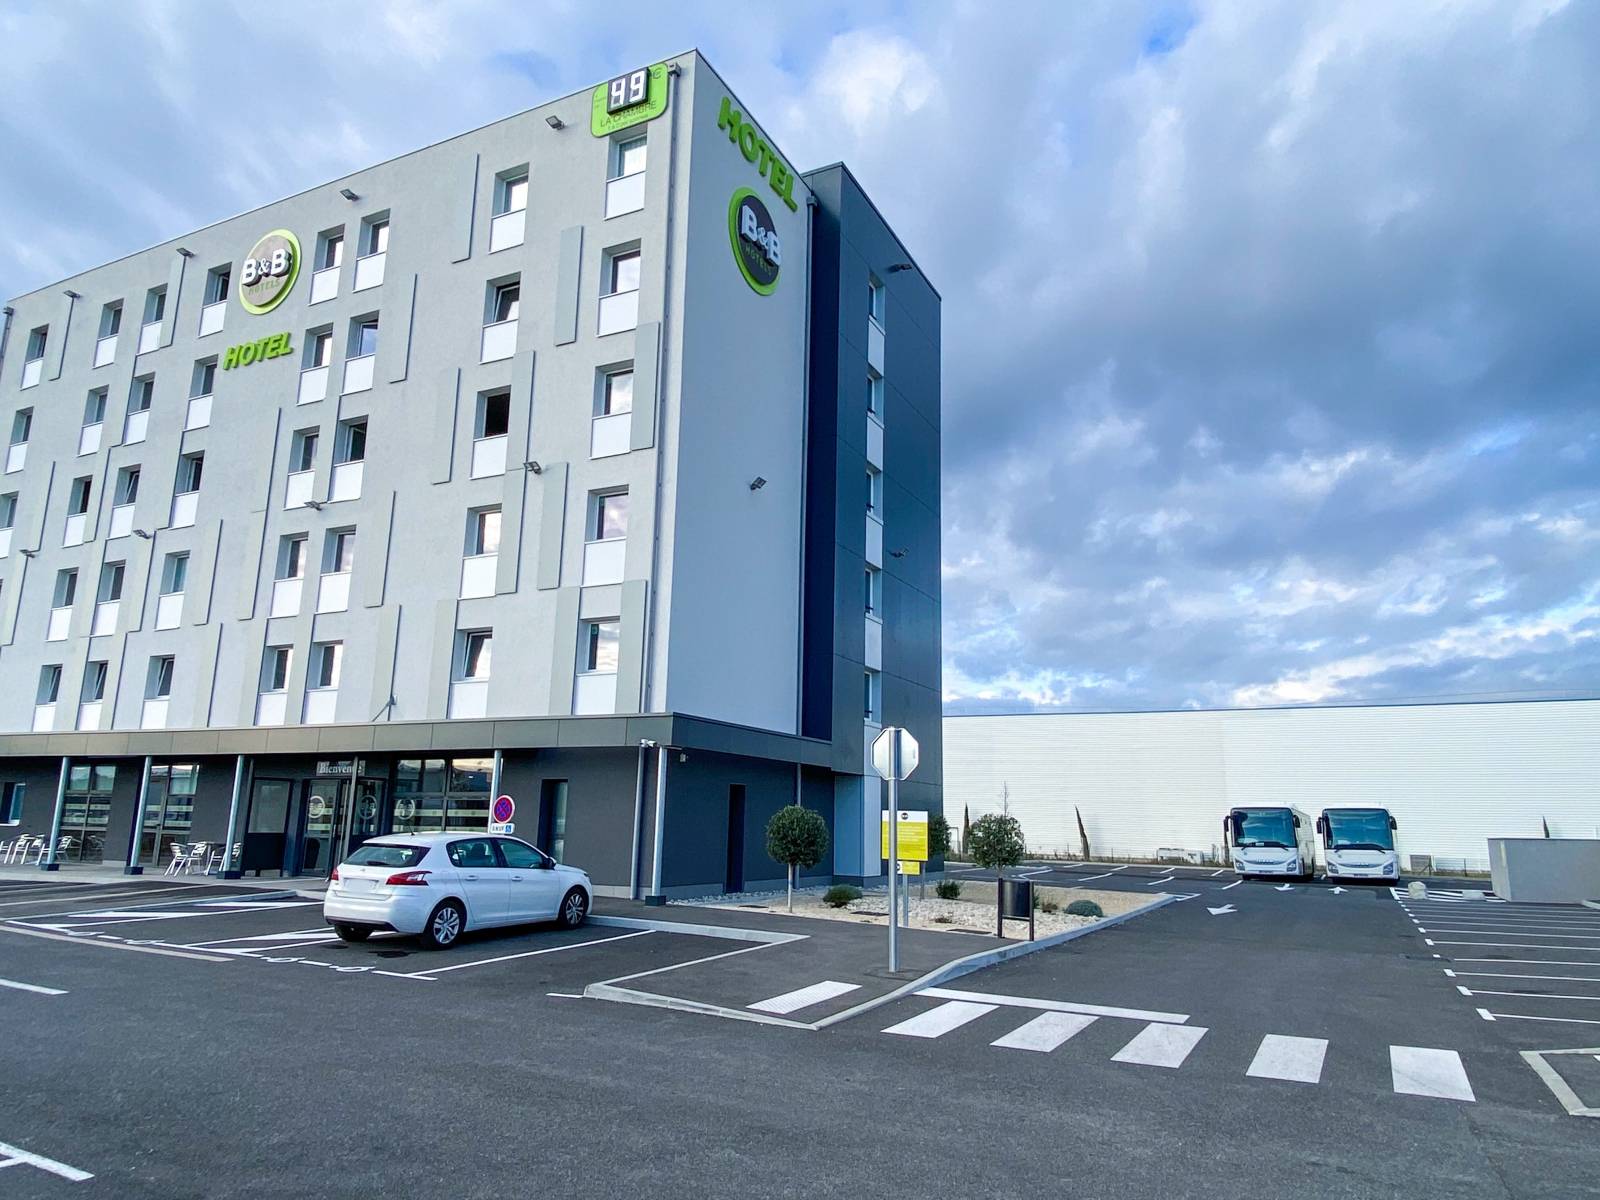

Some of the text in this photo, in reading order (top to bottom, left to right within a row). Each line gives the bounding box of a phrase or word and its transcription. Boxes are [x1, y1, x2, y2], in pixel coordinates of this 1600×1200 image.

[717, 96, 798, 213] HOTEL
[741, 204, 782, 266] B&B
[242, 248, 290, 286] B&B
[223, 331, 293, 370] HOTEL
